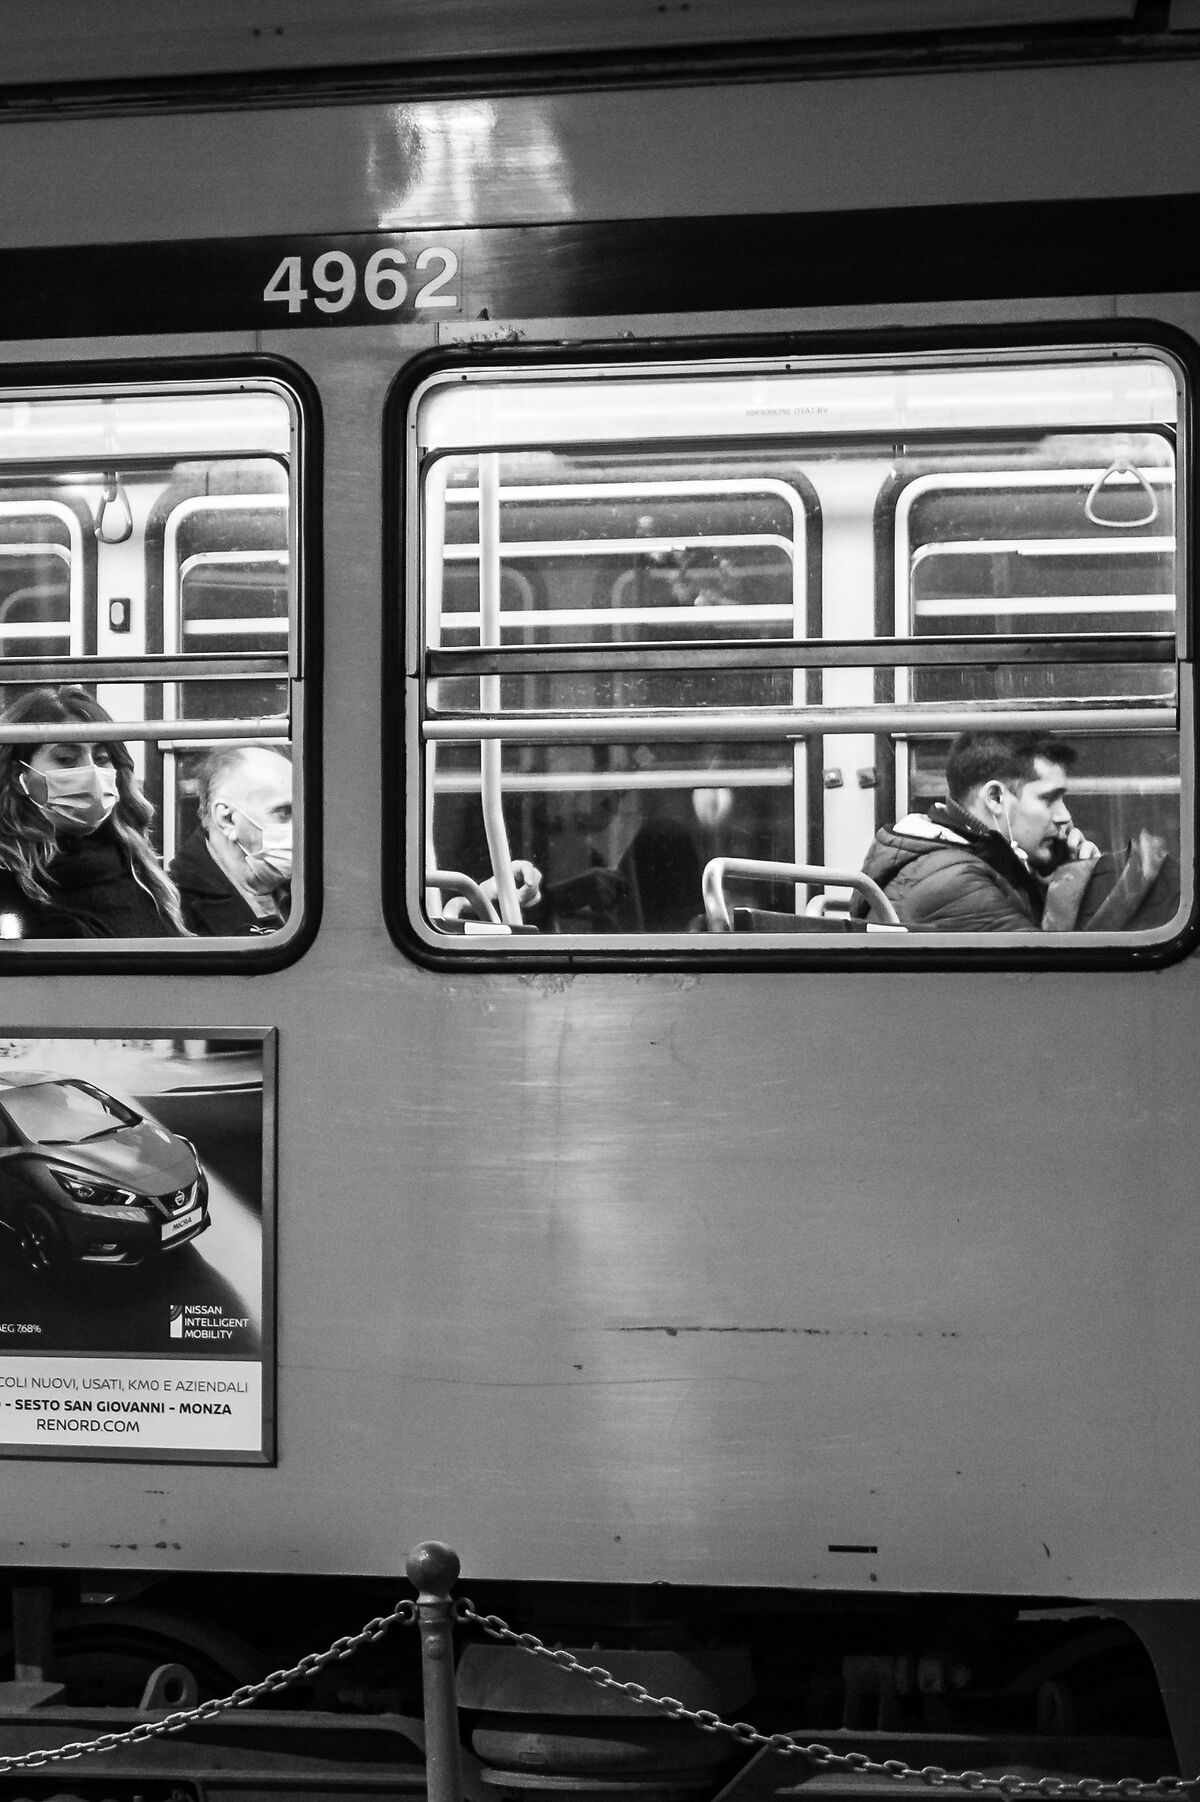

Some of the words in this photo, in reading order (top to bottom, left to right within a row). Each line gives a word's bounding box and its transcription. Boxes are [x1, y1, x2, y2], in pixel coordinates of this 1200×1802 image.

[263, 247, 458, 313] 4962
[184, 1305, 223, 1315] NISSAN
[16, 1323, 42, 1333] 7,68%
[184, 1317, 250, 1328] INTELLIGENT
[184, 1329, 233, 1339] MOBILITY
[31, 1377, 79, 1391] NUOVI,
[82, 1378, 125, 1392] USATI,
[163, 1380, 172, 1392] E
[175, 1380, 248, 1393] AZIENDALI
[15, 1399, 60, 1411] SESTO
[64, 1400, 92, 1412] SAN
[96, 1401, 165, 1413] GIOVANNI
[179, 1403, 232, 1415] MONZA
[36, 1418, 140, 1433] RENORD.COM
